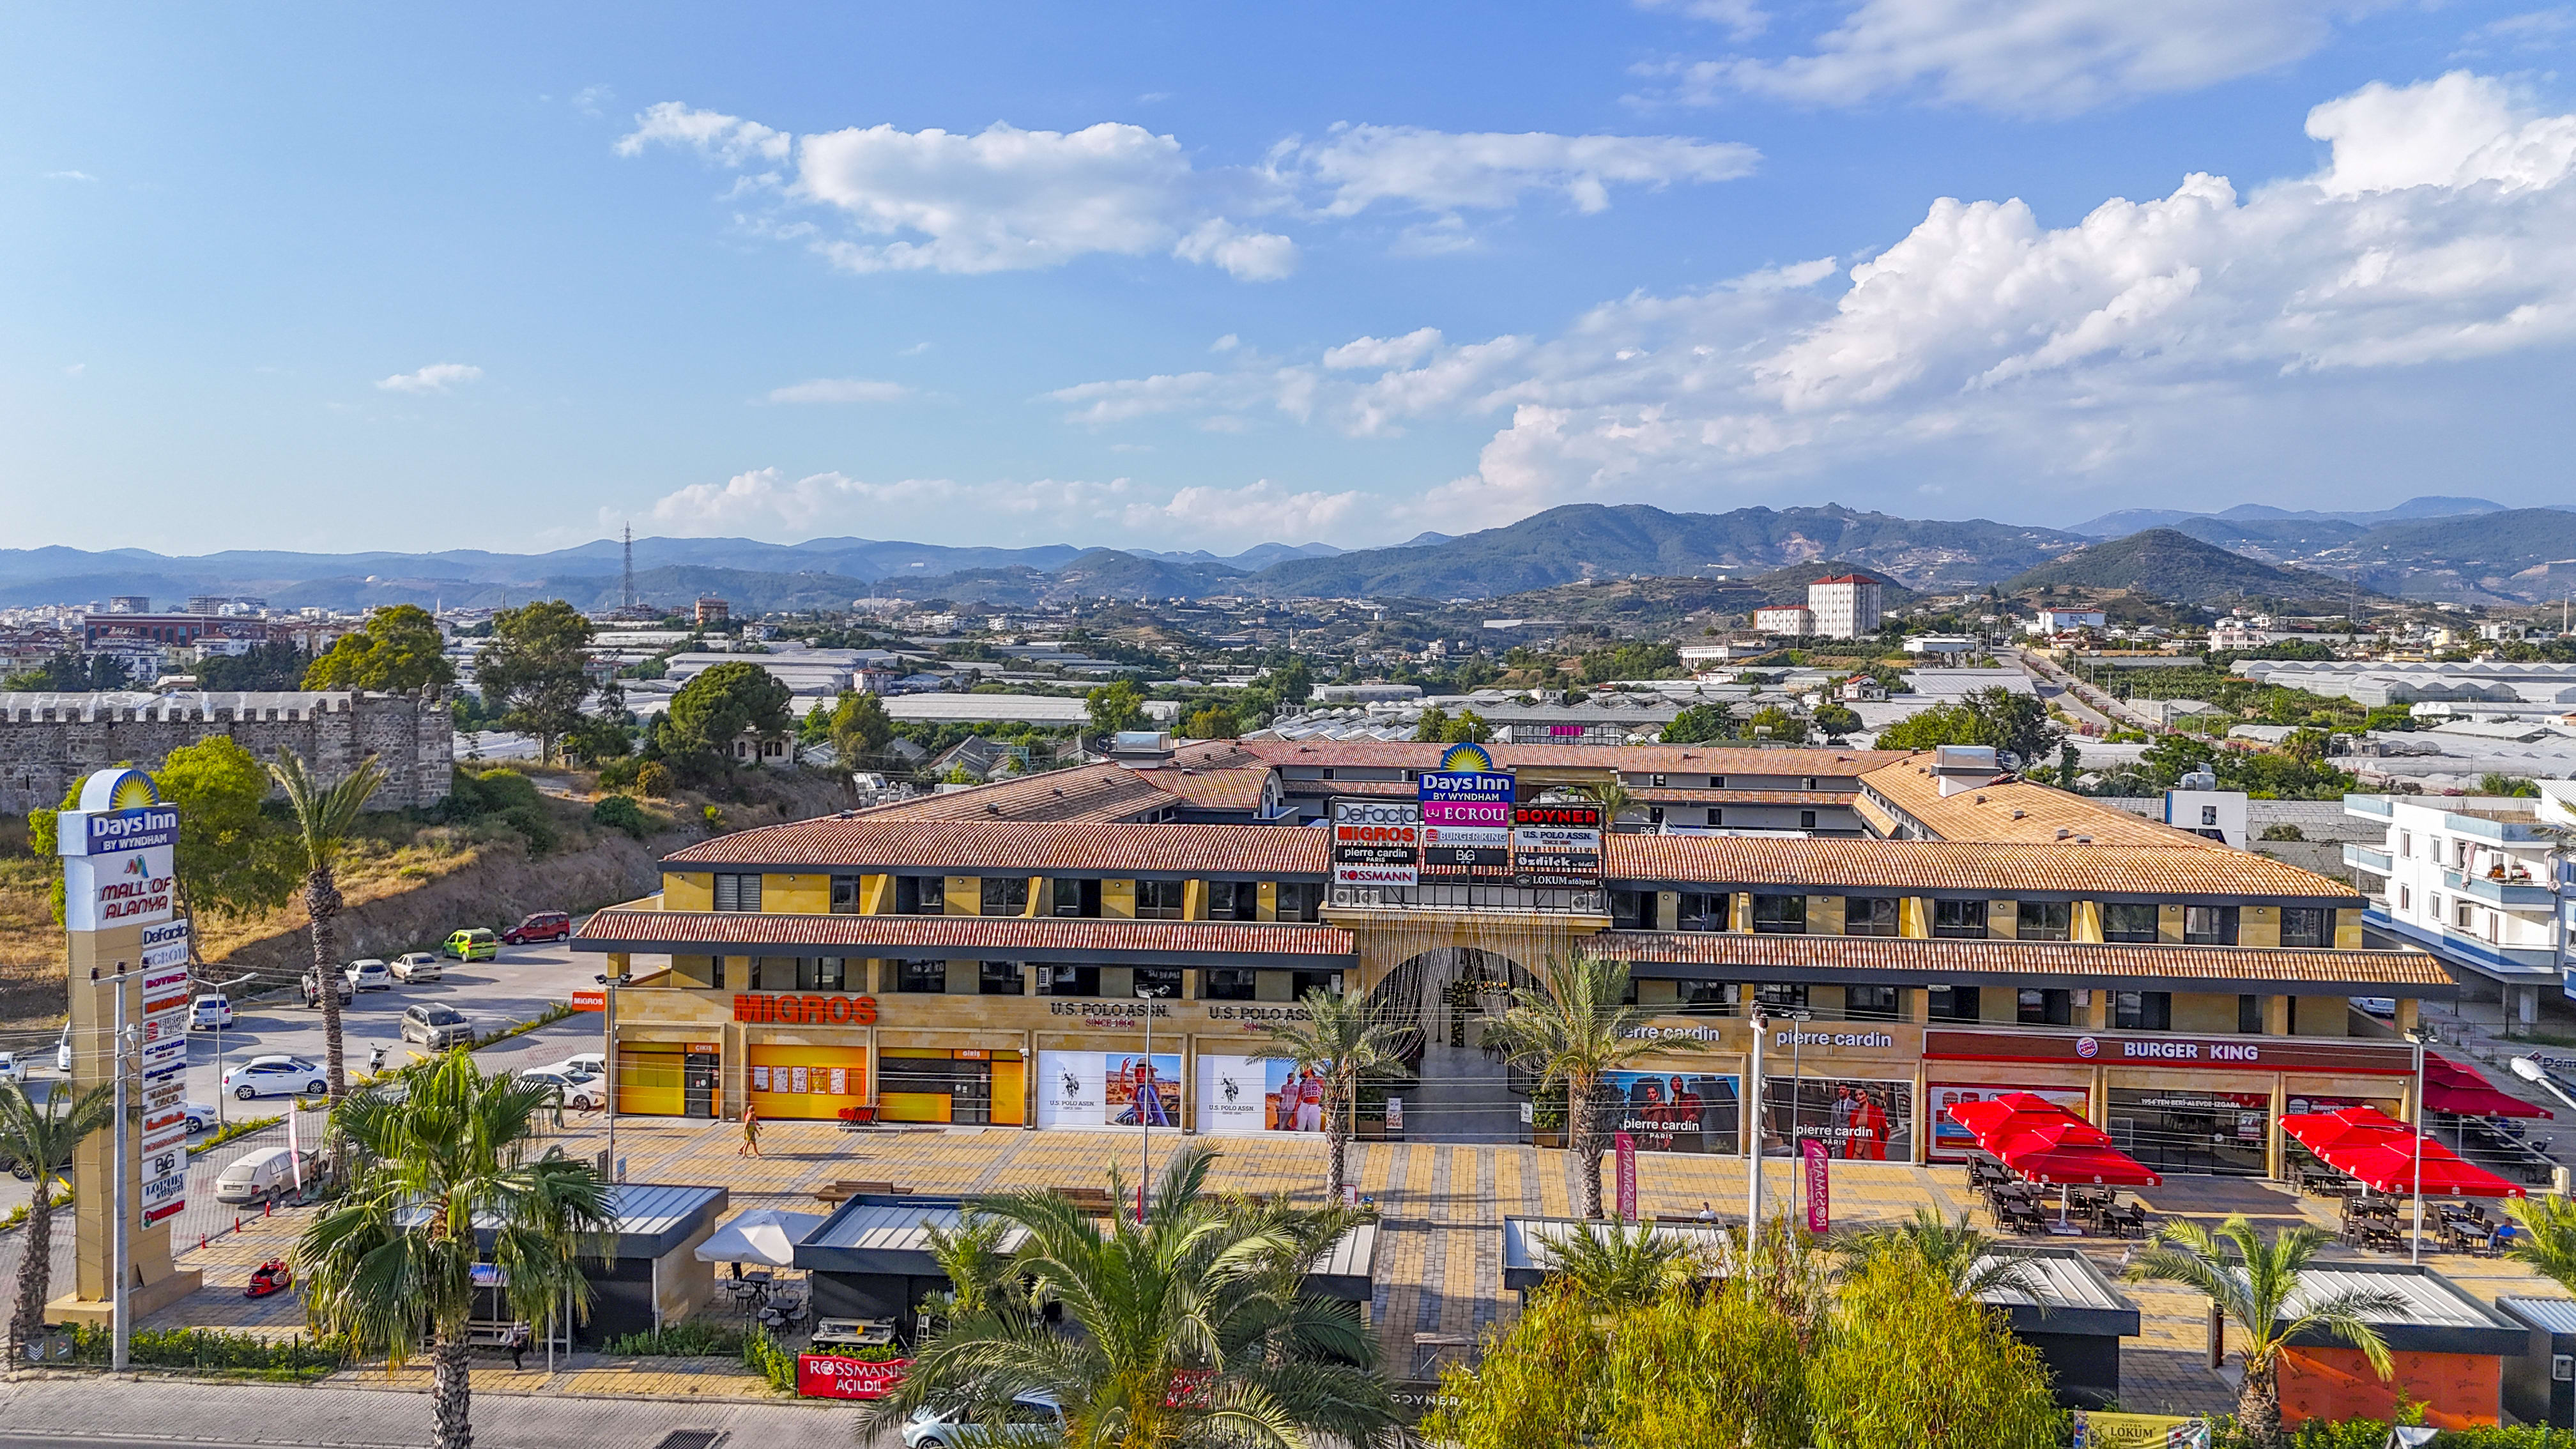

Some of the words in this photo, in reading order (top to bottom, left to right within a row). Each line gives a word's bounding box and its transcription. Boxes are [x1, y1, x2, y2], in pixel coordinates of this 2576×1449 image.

[1423, 774, 1473, 792] Days
[1476, 776, 1509, 790] Inn
[1448, 793, 1499, 801] WYNDHAM
[1336, 804, 1417, 822] DeFacto
[1445, 808, 1506, 820] ECROU
[1516, 809, 1596, 823] BOYNER
[92, 816, 143, 836] Days
[144, 812, 176, 830] Inn
[103, 840, 117, 850] BY
[119, 834, 167, 848] WYNDHAM
[1440, 832, 1478, 841] BURGER
[1481, 833, 1506, 841] KING
[1345, 848, 1374, 858] pierre
[1377, 848, 1407, 857] cardin
[1456, 850, 1475, 861] B&G
[1518, 854, 1571, 867] Özdilek
[1340, 870, 1412, 881] ROSSMANN
[1533, 875, 1568, 885] LOKUM
[100, 880, 146, 901] MALL
[150, 877, 172, 894] OF
[104, 895, 167, 919] ALANYA
[144, 924, 187, 944] DeFacto
[148, 947, 187, 965] CROU
[1050, 1002, 1078, 1015] U.S.
[1081, 1004, 1122, 1016] POLO
[1125, 1004, 1170, 1017] ASSN.
[1209, 1007, 1236, 1019] U.S.
[1240, 1008, 1280, 1020] POLO
[1285, 1008, 1314, 1020] ASS
[160, 1014, 189, 1027] BURGER
[1085, 1018, 1112, 1027] SINCE
[1243, 1022, 1259, 1031] SIN
[1618, 1026, 1659, 1038] ierre
[1663, 1025, 1719, 1041] cardin
[1776, 1029, 1830, 1047] pierre
[1834, 1031, 1892, 1047] cardin
[2124, 1041, 2198, 1059] BURGER
[2210, 1044, 2258, 1061] KING
[1624, 1118, 1659, 1131] pierre
[1662, 1119, 1699, 1131] cardin
[1796, 1124, 1832, 1137] pierre
[1835, 1126, 1873, 1137] cardin
[155, 1153, 174, 1174] B&G
[146, 1173, 183, 1196] LOKUM
[810, 1361, 907, 1377] ROSSMANN
[836, 1379, 881, 1394] AÇILDI!
[2111, 1427, 2152, 1438] LOKUM
